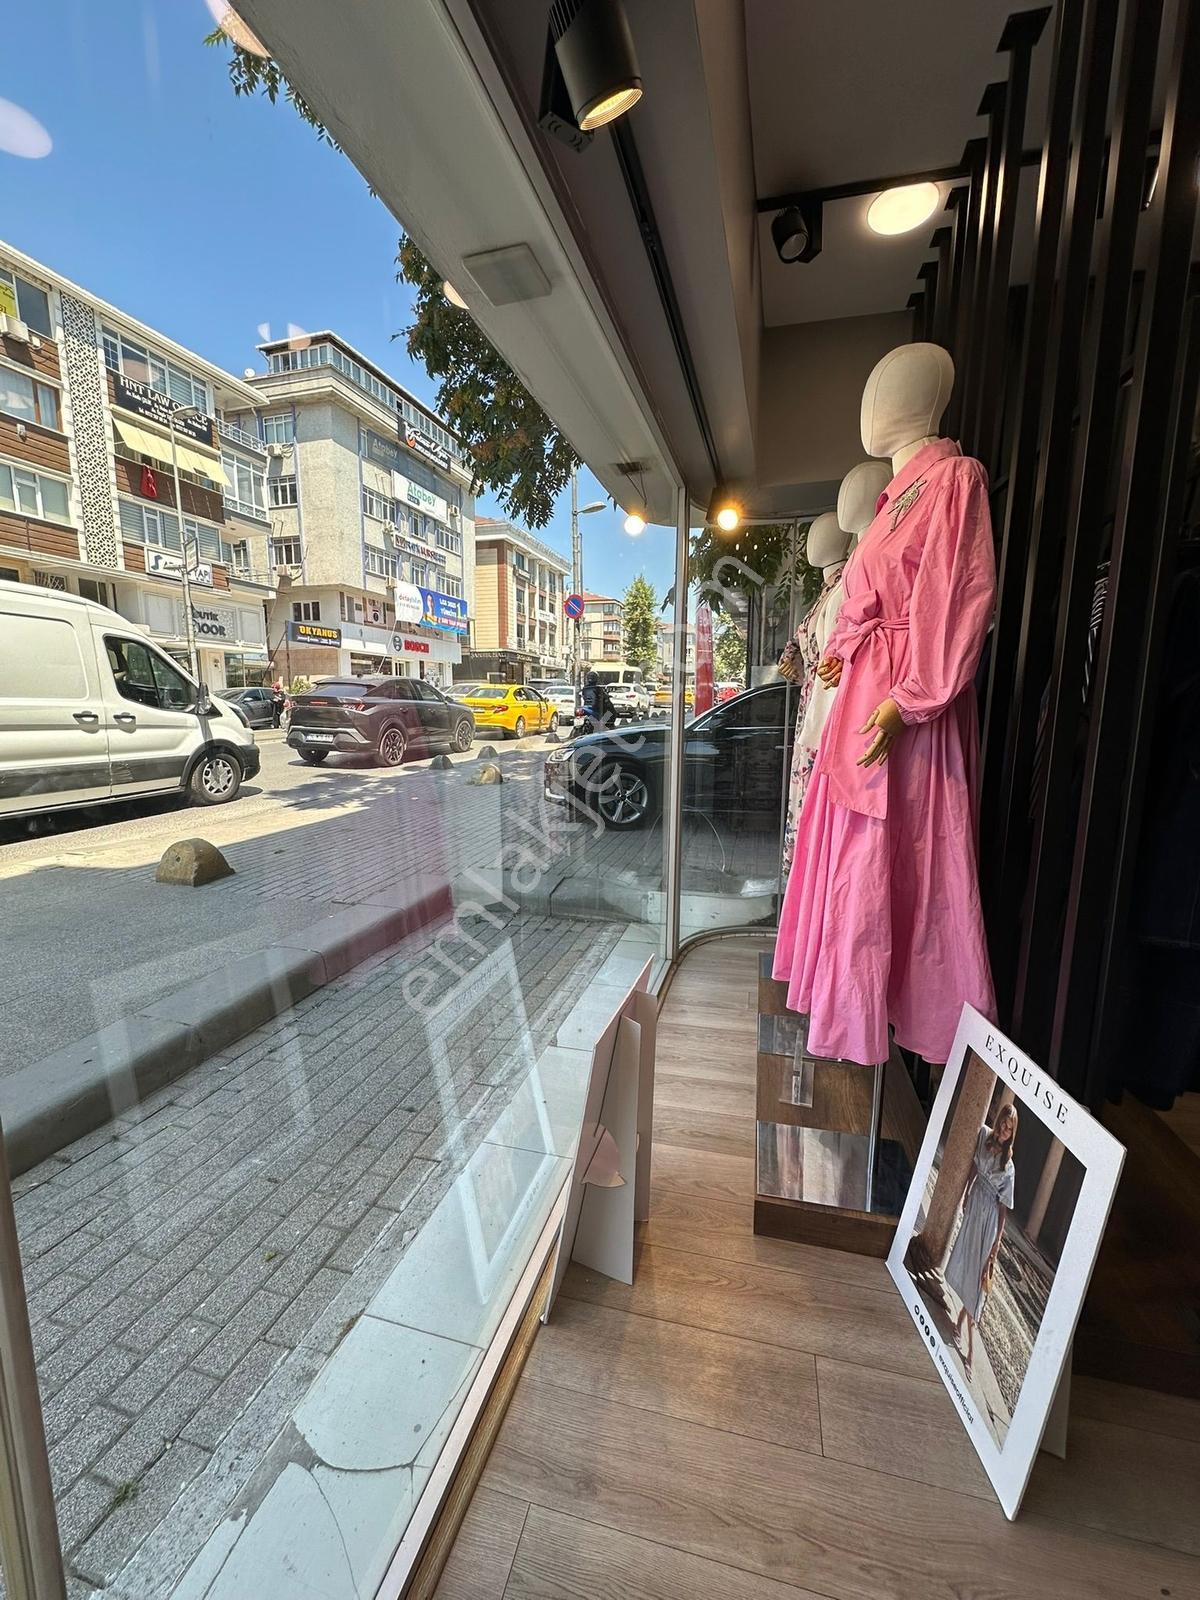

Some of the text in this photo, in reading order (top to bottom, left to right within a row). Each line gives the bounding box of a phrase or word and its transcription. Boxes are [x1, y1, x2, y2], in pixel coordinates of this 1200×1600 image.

[120, 376, 145, 395] HNT
[147, 389, 170, 407] LAW
[172, 401, 208, 426] OCE
[985, 1034, 1069, 1124] EXQUISE
